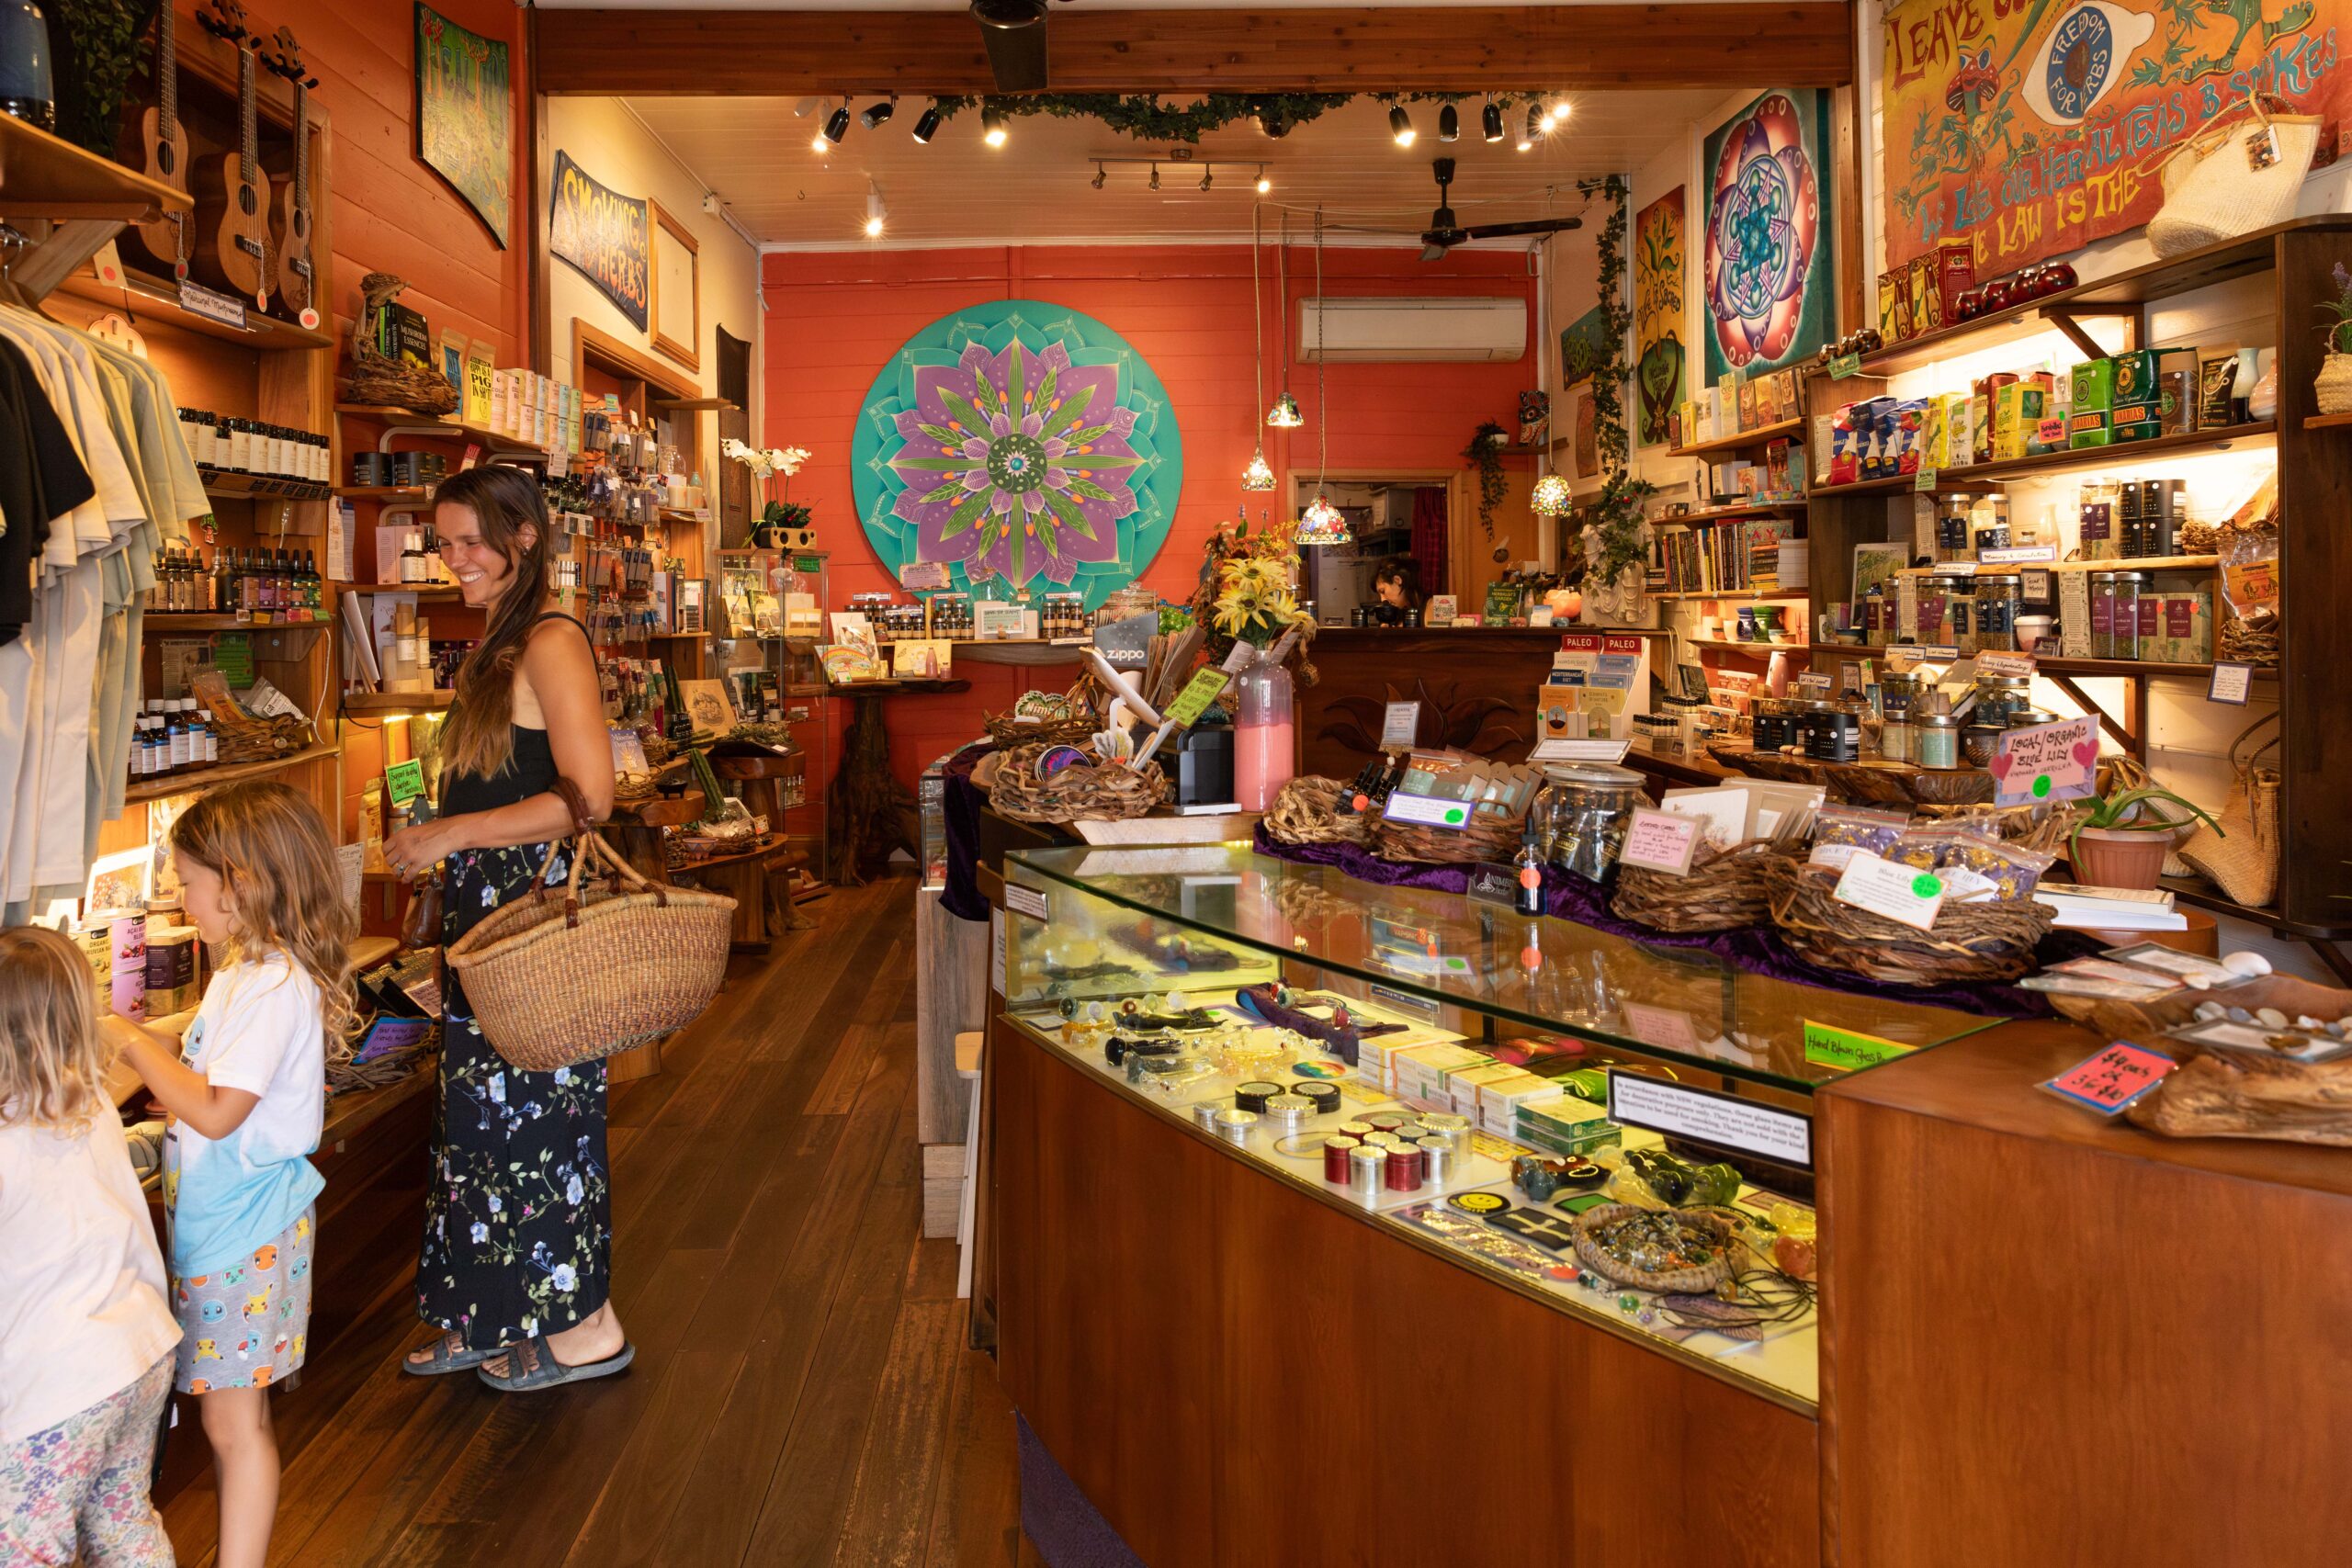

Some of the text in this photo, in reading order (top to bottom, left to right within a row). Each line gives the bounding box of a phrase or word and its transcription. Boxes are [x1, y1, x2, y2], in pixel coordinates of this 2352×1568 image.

[2050, 76, 2076, 114] FOR
[2040, 126, 2122, 197] HERAL
[2120, 92, 2187, 158] TEAS
[1996, 202, 2042, 258] LAW
[2086, 161, 2142, 220] THE
[598, 243, 646, 310] HERBS
[470, 373, 492, 388] PIG
[2072, 413, 2101, 430] ANARIAS
[1566, 637, 1635, 649] PALEO PALEO
[2017, 749, 2068, 767] BLUE LILY
[89, 939, 109, 948] ORGANIC
[1808, 1034, 1829, 1051] Hand
[1624, 1084, 1659, 1097] accordance
[1661, 1090, 1675, 1100] with
[1665, 1100, 1694, 1114] purposes
[1713, 1112, 1728, 1123] They
[1757, 1122, 1771, 1133] sold
[1772, 1127, 1788, 1137] with
[1790, 1132, 1801, 1140] the
[1723, 1122, 1744, 1135] Thank
[1789, 1139, 1804, 1149] kind
